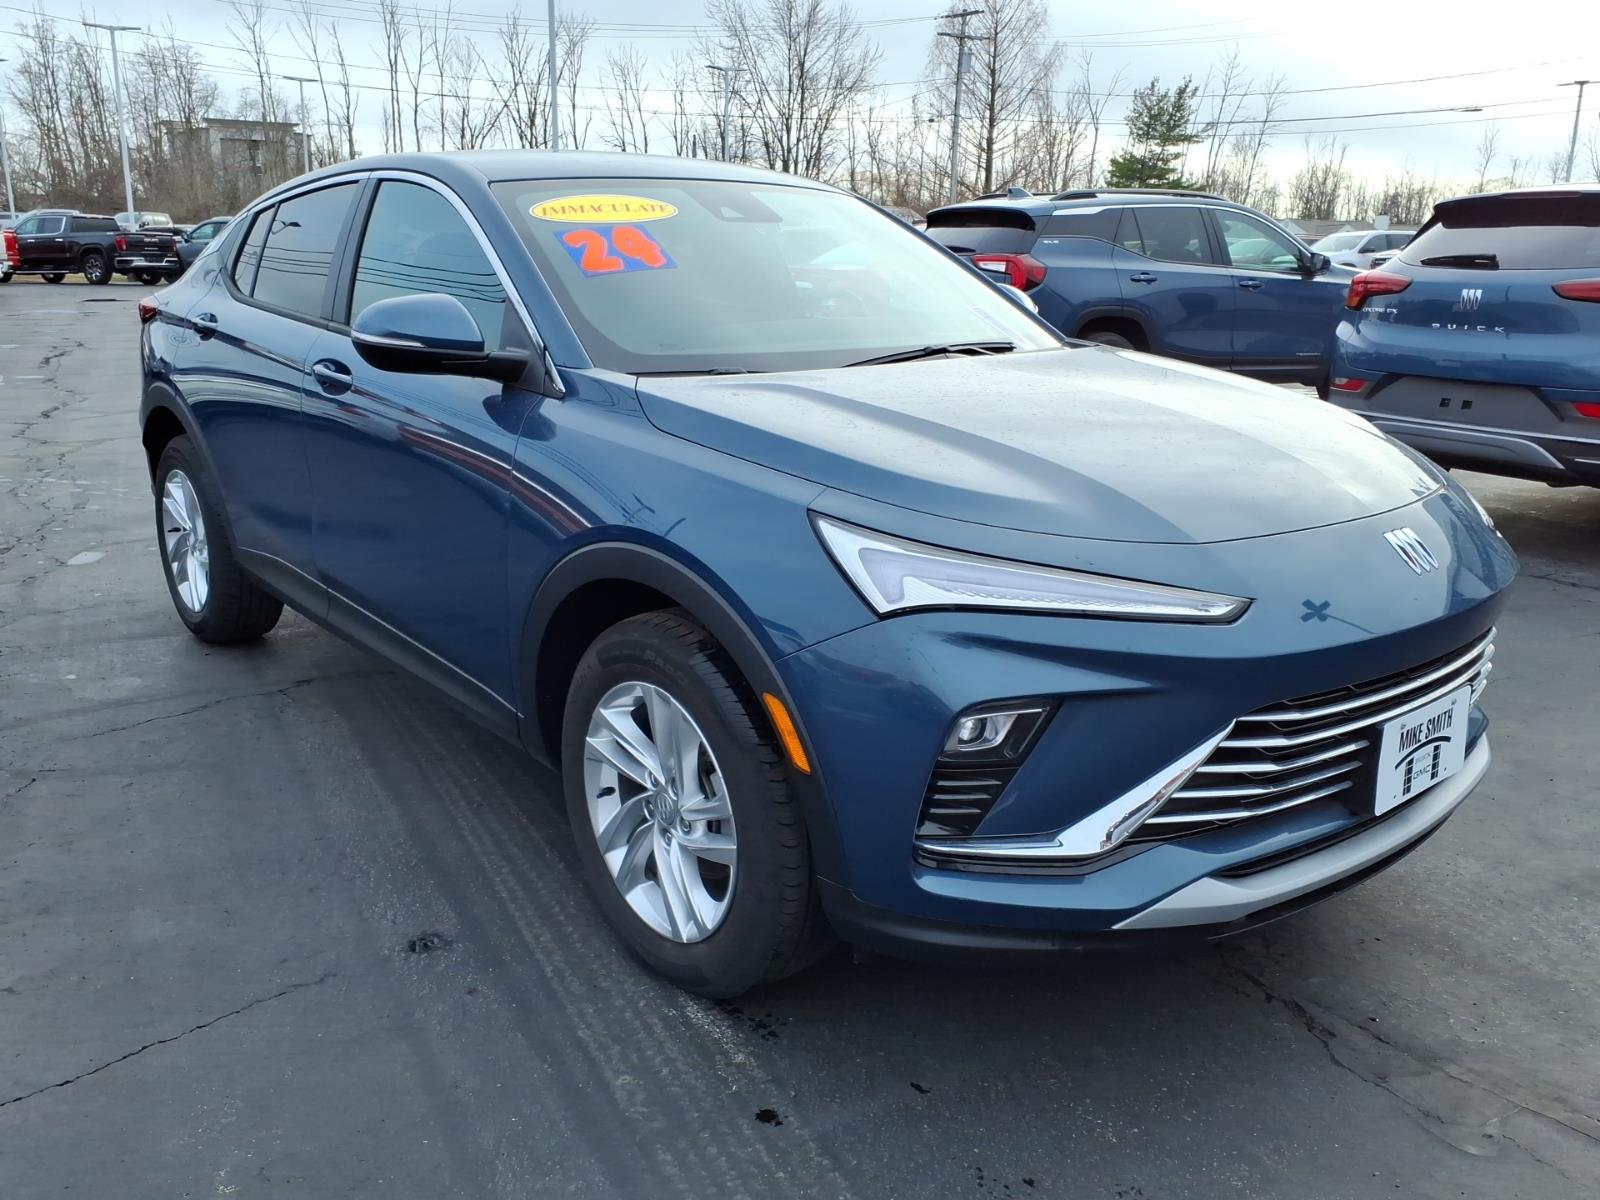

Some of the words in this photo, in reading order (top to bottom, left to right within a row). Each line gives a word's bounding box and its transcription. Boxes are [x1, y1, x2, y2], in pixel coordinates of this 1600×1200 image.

[541, 202, 669, 216] IMMACULATE
[562, 225, 668, 273] 24
[1431, 323, 1505, 334] BUICK
[1398, 724, 1423, 753] MIKE
[1425, 707, 1454, 740] SMITH
